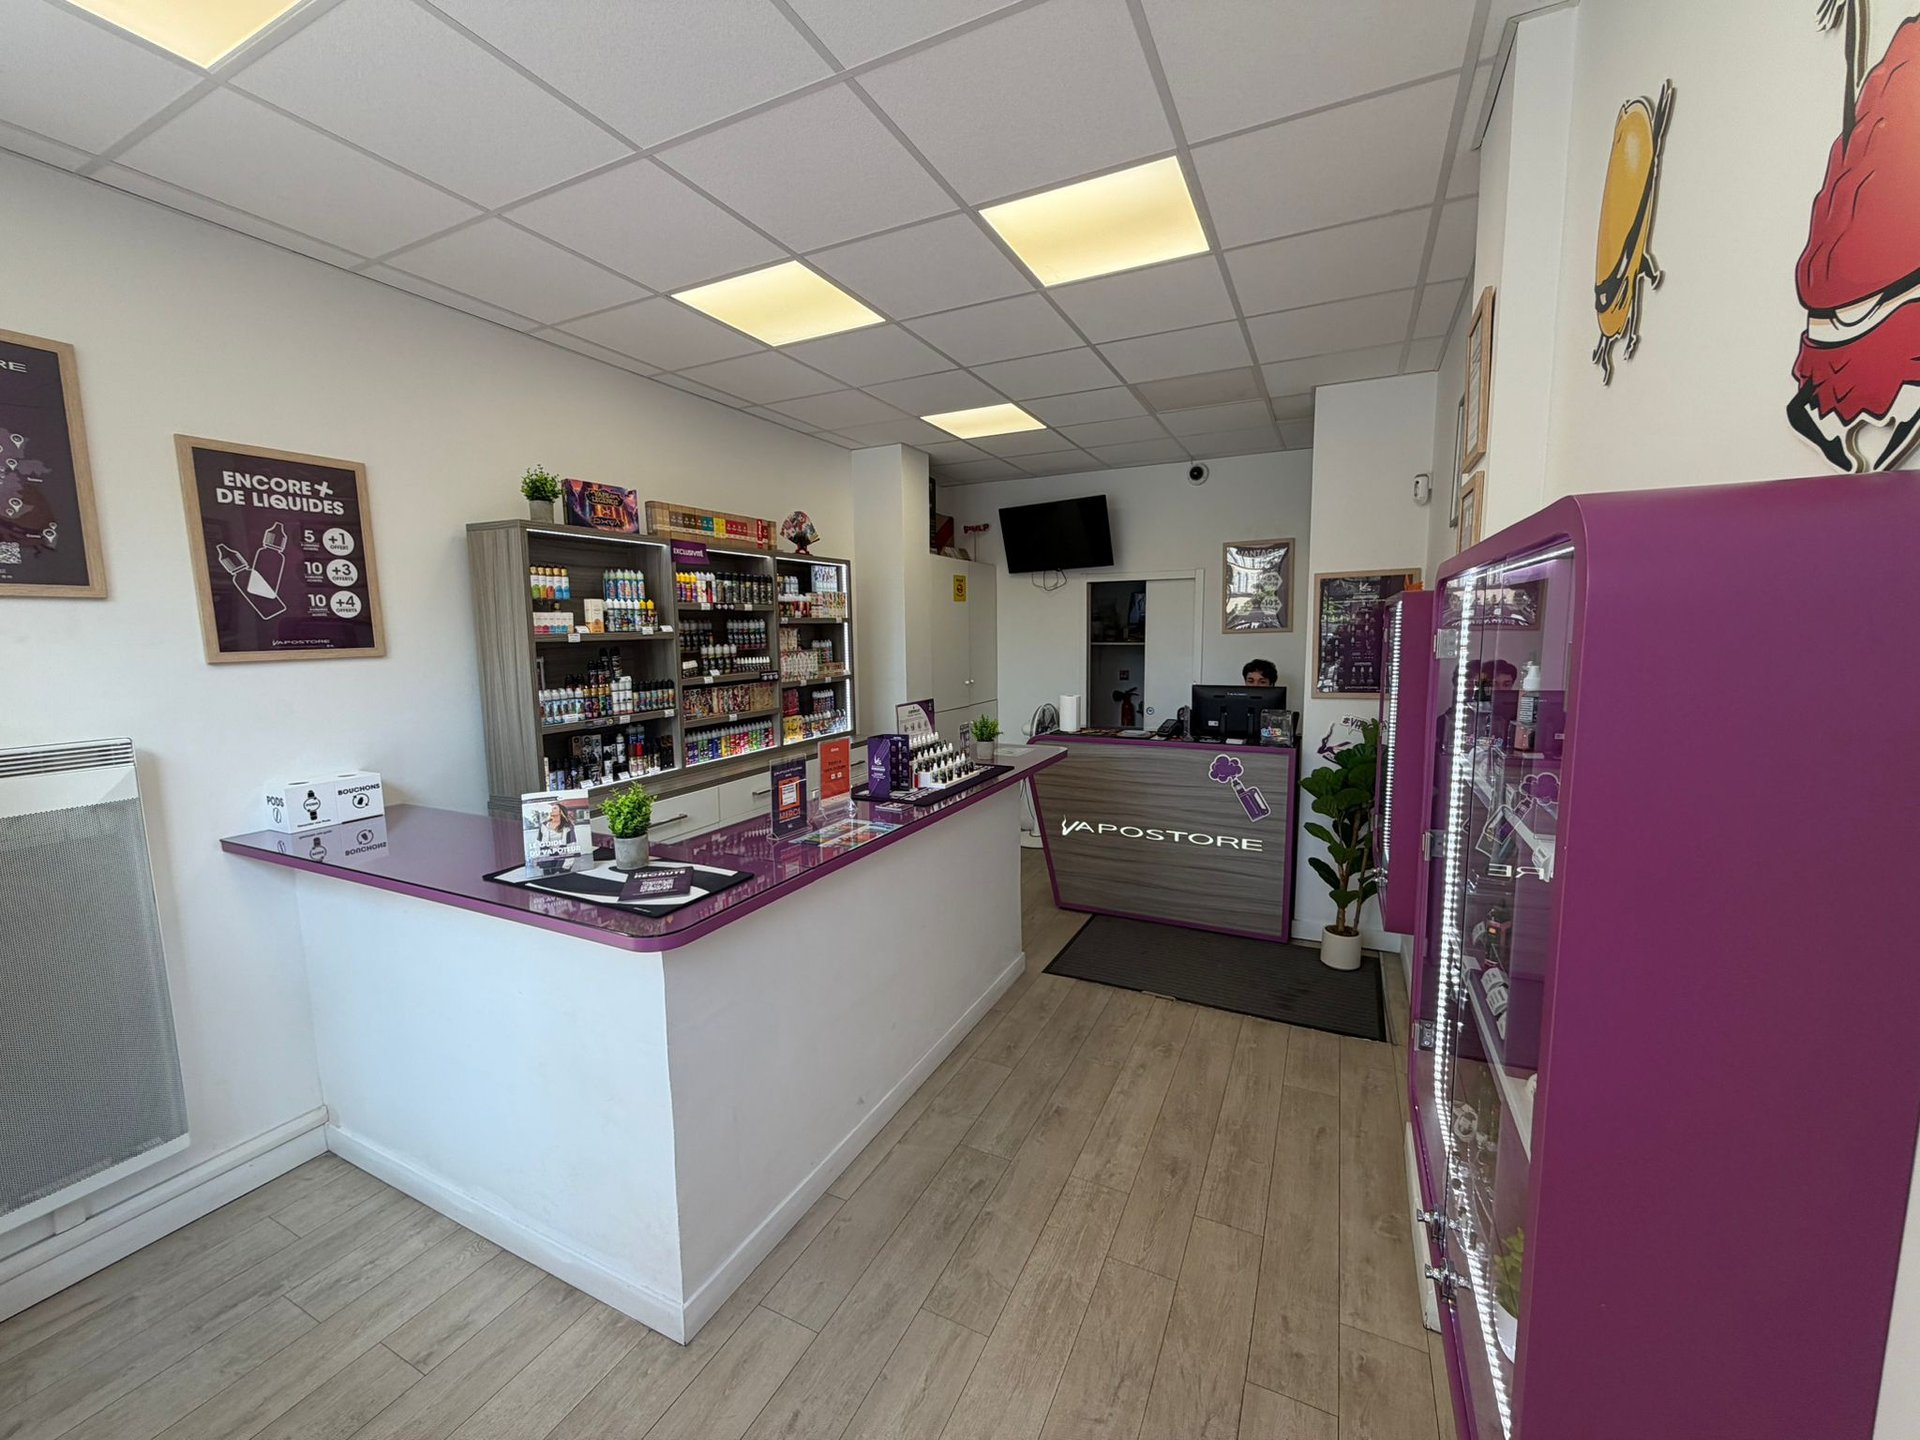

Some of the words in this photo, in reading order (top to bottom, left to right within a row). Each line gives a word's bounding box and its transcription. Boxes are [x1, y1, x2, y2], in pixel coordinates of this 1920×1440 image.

[222, 470, 312, 496] ENCORE
[215, 487, 246, 506] DE
[251, 491, 345, 516] LIQUIDES
[303, 529, 316, 543] 5
[328, 532, 346, 545] +1
[303, 561, 324, 576] 10
[331, 563, 352, 576] +3
[307, 593, 327, 608] 10
[335, 595, 356, 608] +4
[272, 638, 330, 646] VAPOSTORE
[337, 783, 381, 796] BOUCHONS
[266, 795, 285, 808] PODS
[1061, 815, 1263, 851] VAPOSTORE
